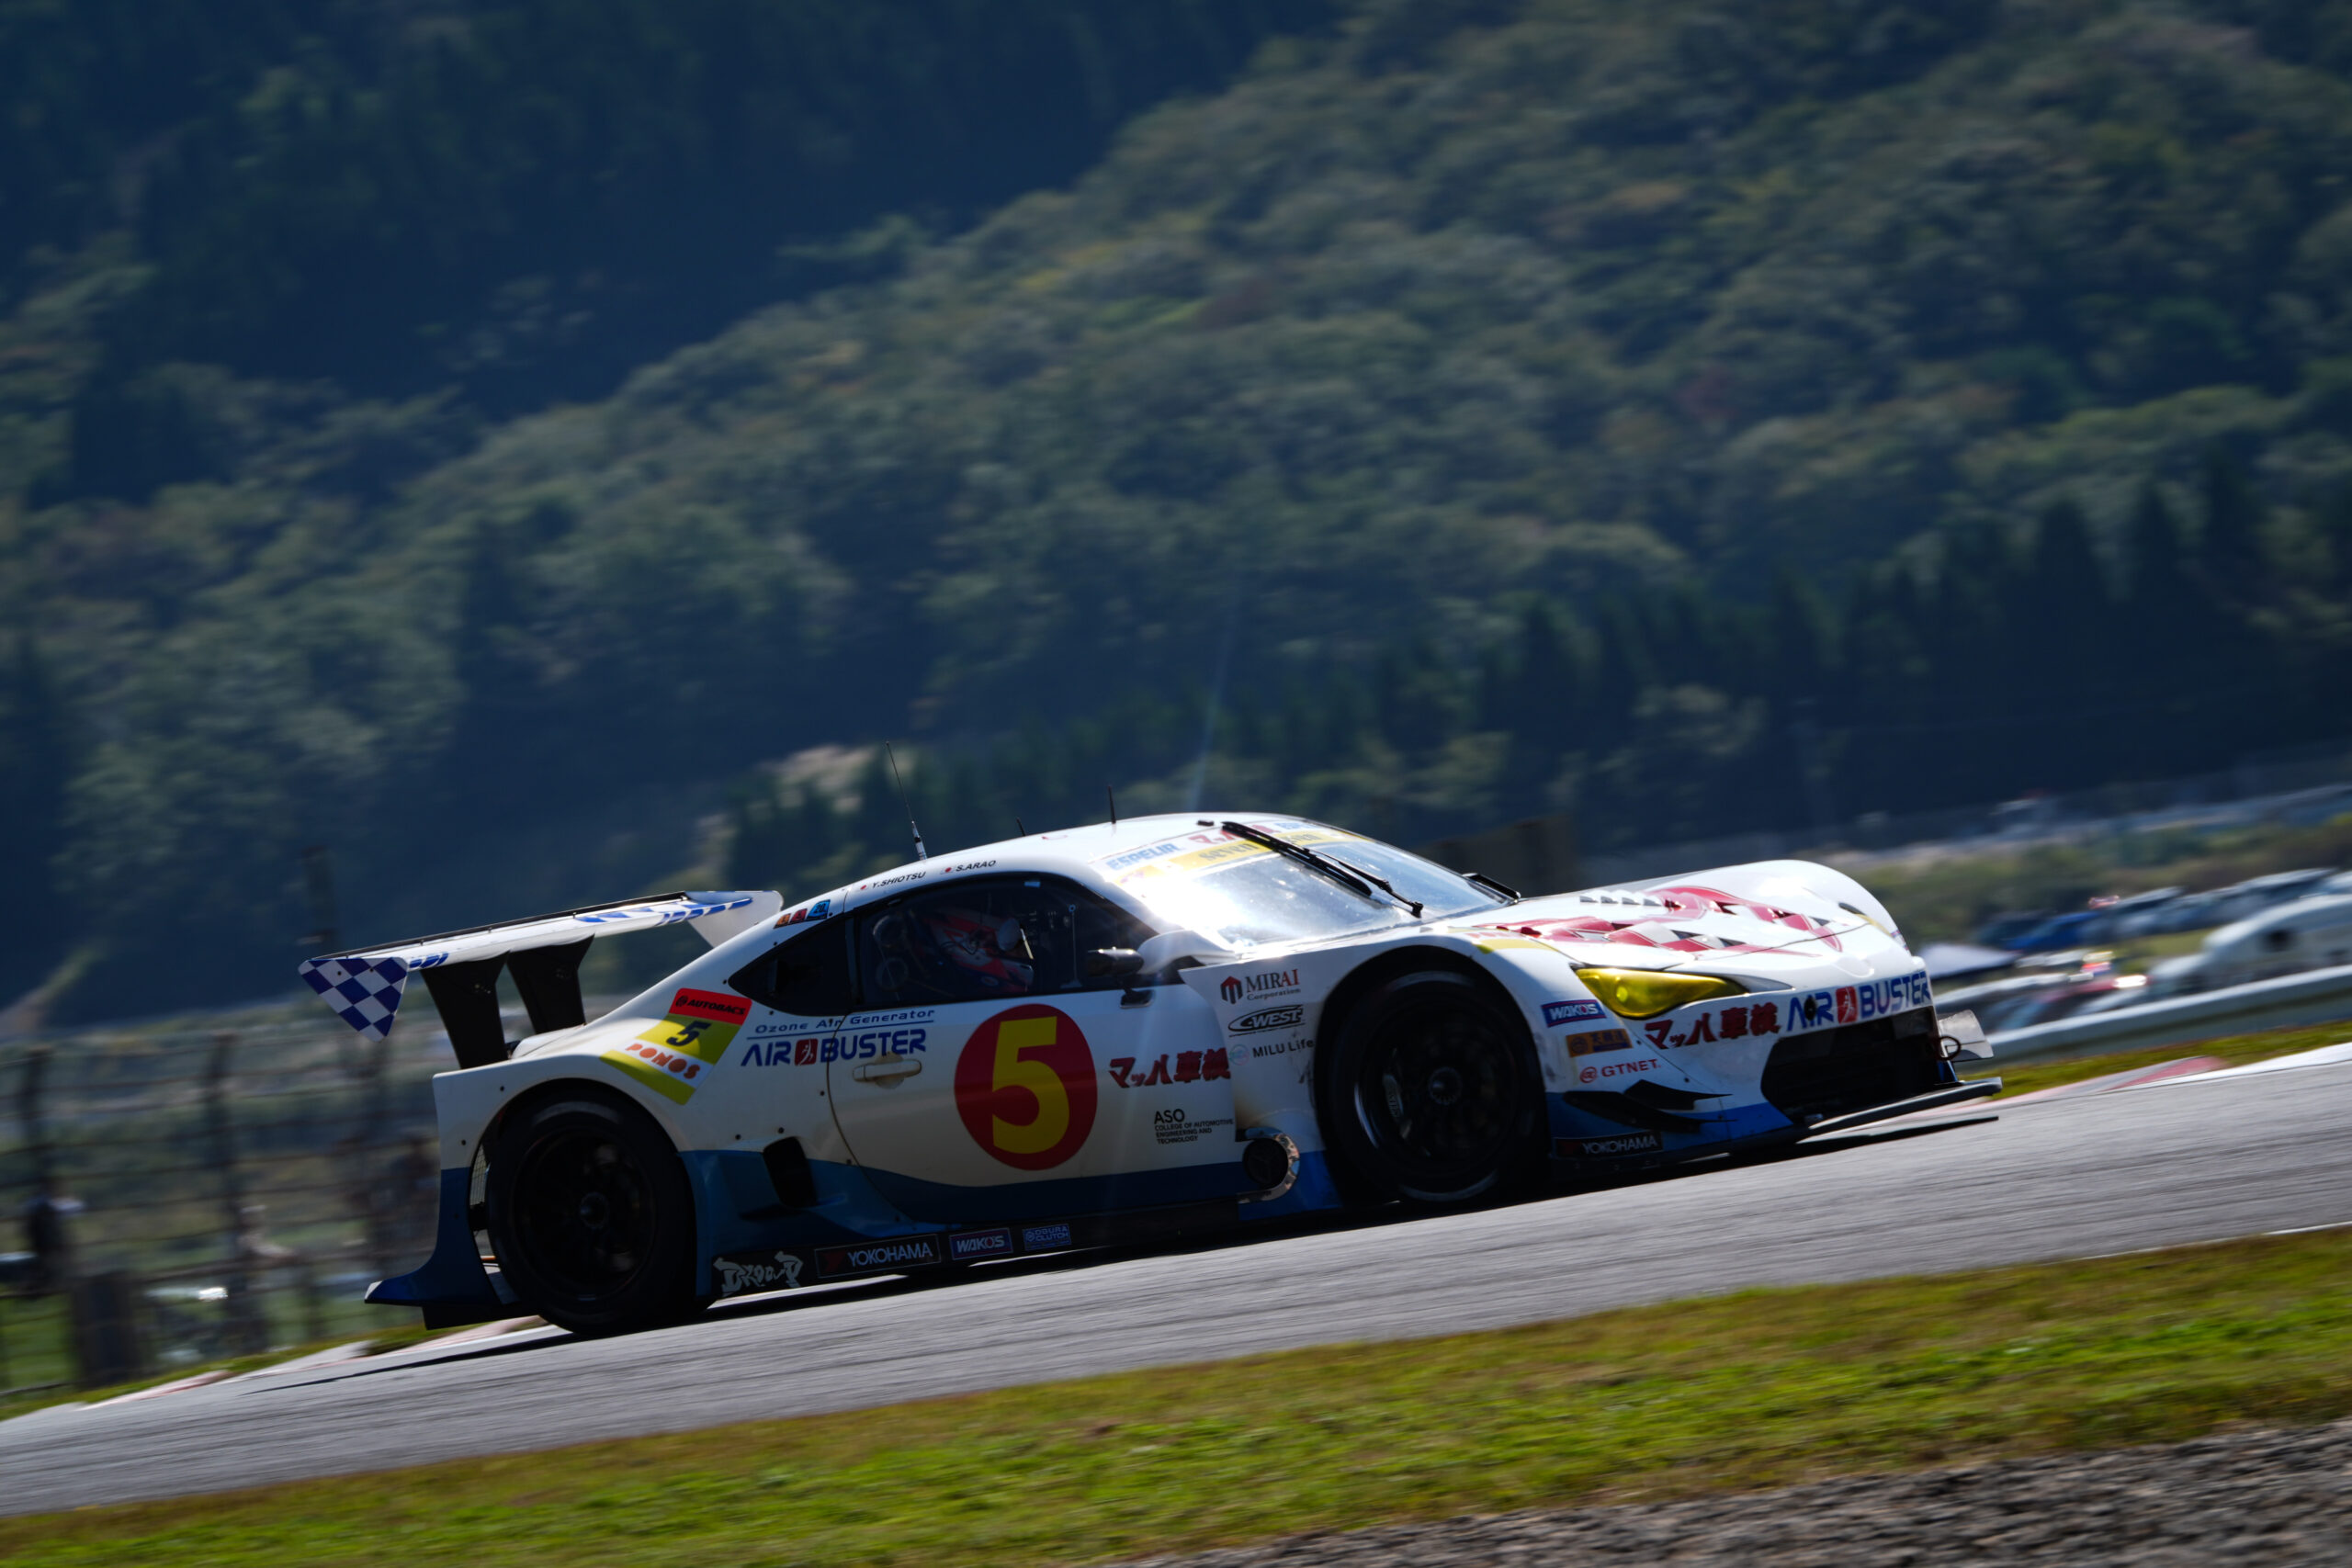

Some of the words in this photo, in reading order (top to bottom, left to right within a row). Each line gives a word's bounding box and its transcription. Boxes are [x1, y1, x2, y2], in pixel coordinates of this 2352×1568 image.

[955, 859, 998, 873] S.ARAO
[872, 871, 927, 888] Y.SHIOTSU
[1245, 968, 1300, 993] MIRAI
[686, 998, 747, 1016] AUTOBACS
[1246, 987, 1301, 1002] Corporation
[1787, 990, 1834, 1032] AIR
[1859, 969, 1931, 1019] BUSTER
[665, 1020, 713, 1047] 5
[754, 1021, 808, 1034] Ozone
[849, 1009, 935, 1026] Generator
[1644, 1001, 1781, 1050] マッハ車検
[740, 1041, 793, 1067] AIR
[820, 1028, 927, 1063] BUSTER
[1251, 1043, 1285, 1059] MILU
[624, 1043, 701, 1080] PONOS
[1108, 1046, 1231, 1089] マッハ車検
[1600, 1058, 1659, 1077] GTNET
[992, 1015, 1070, 1155] 5
[1154, 1108, 1185, 1125] ASO
[1581, 1134, 1658, 1155] YOKOHAMA
[847, 1242, 934, 1268] YOKOHAMA
